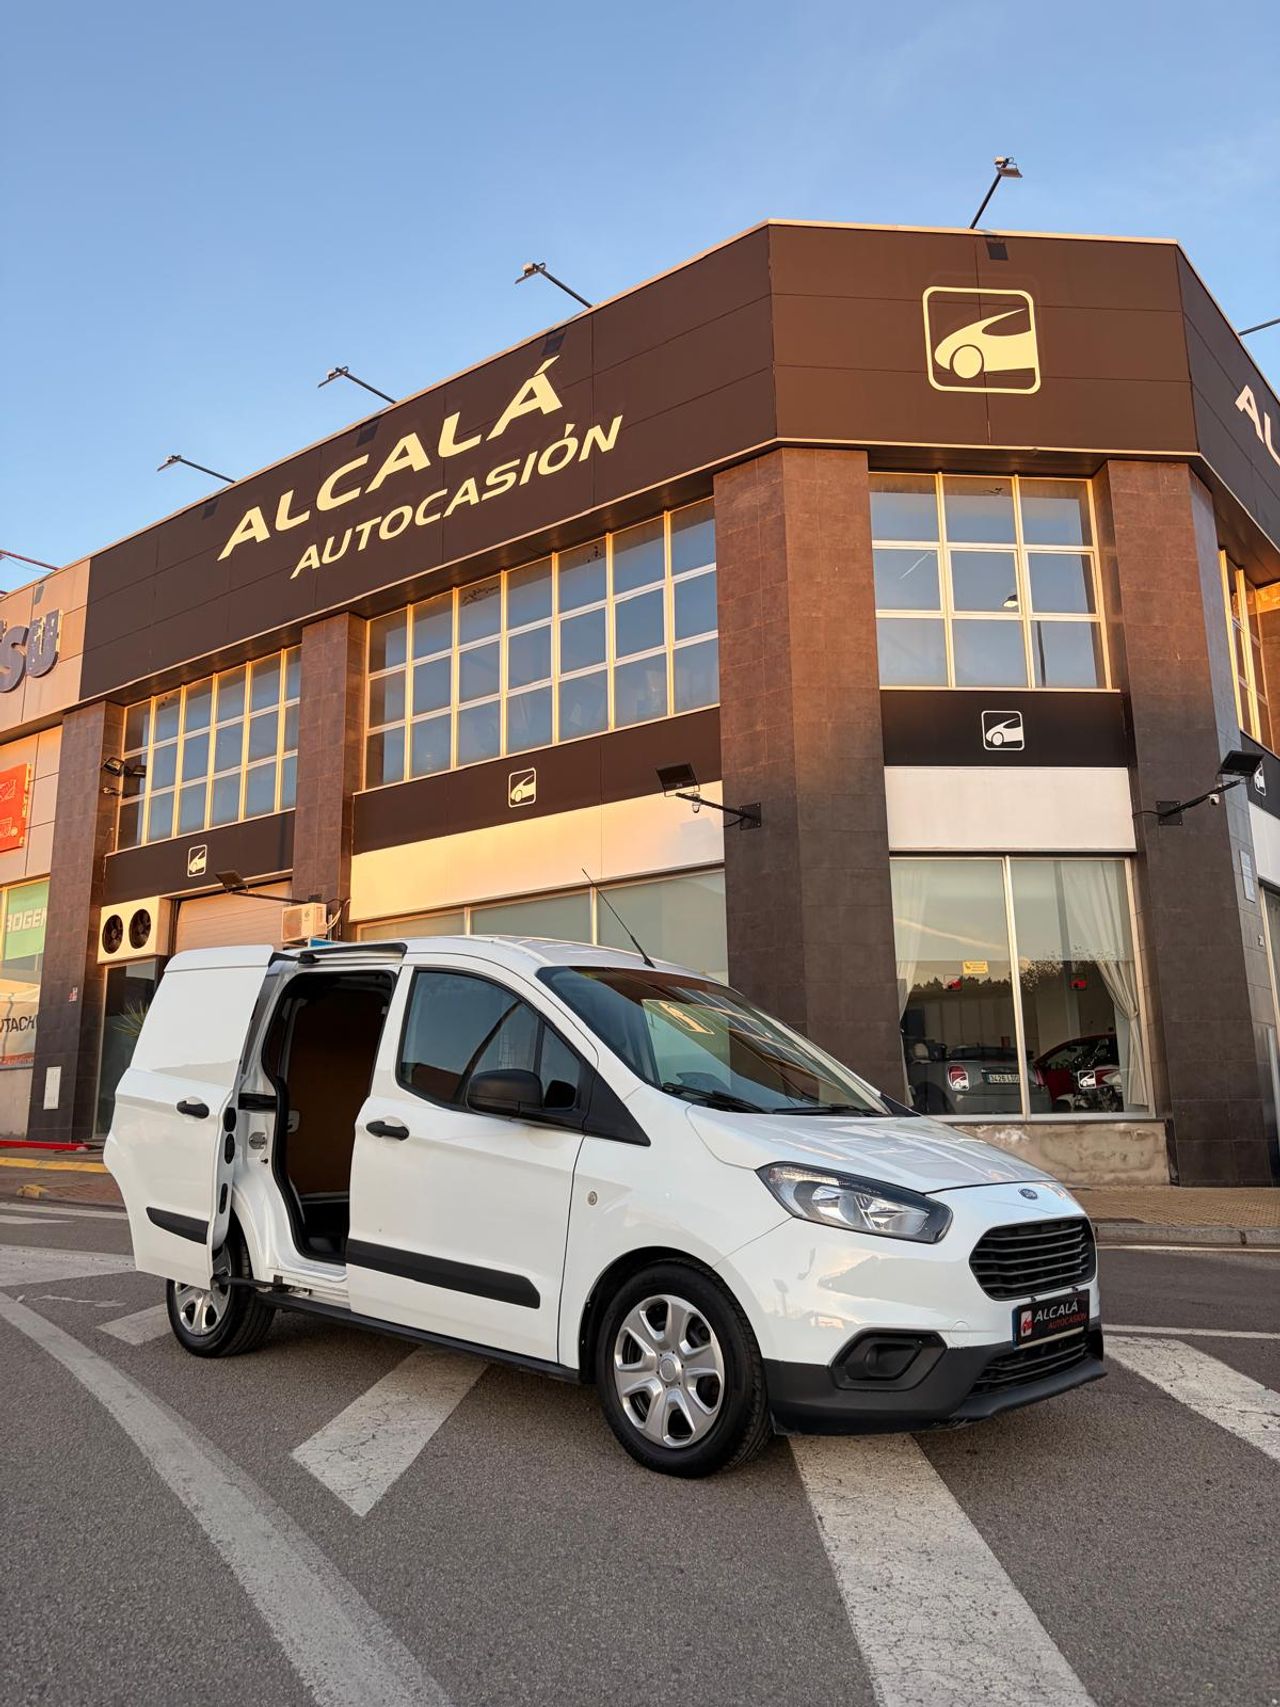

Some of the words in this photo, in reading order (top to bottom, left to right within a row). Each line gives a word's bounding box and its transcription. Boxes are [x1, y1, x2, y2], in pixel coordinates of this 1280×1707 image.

[217, 355, 563, 561] ALCALÁ
[290, 415, 623, 579] AUTOCASIÓN
[0, 609, 63, 693] SU
[1034, 1298, 1078, 1323] ALCALÁ
